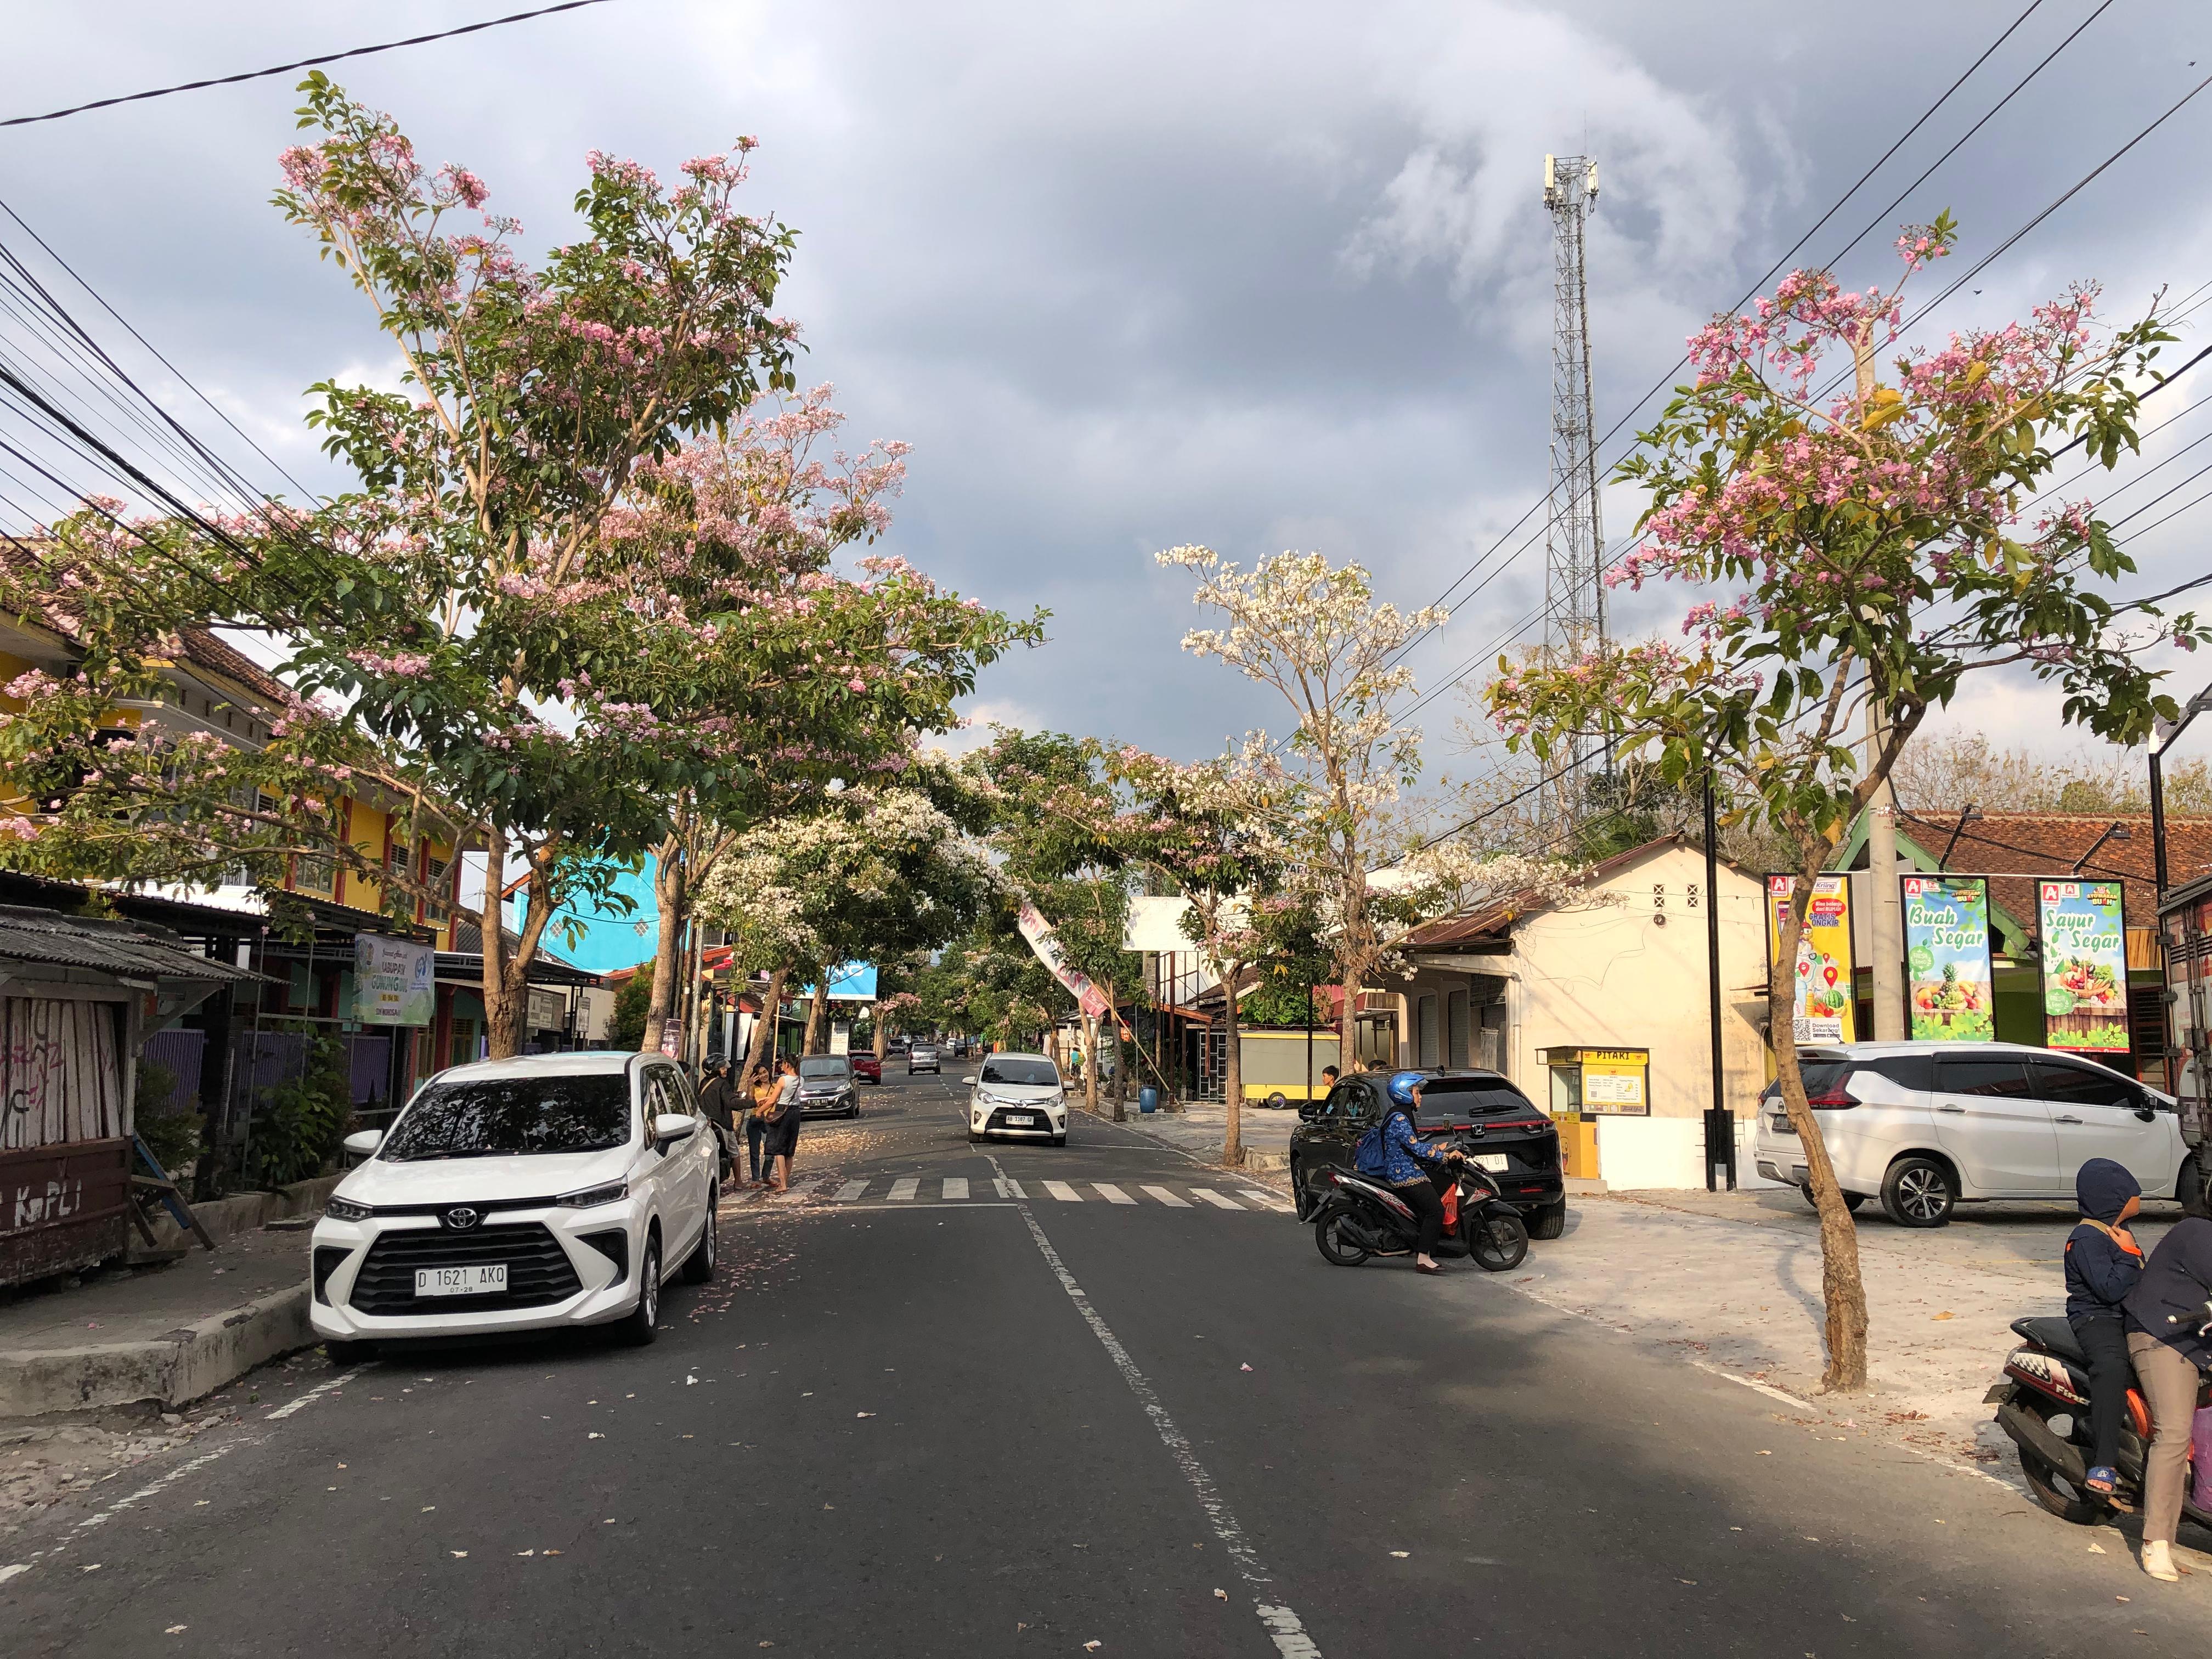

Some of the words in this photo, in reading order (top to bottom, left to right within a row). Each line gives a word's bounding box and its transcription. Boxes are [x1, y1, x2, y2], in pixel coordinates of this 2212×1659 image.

[1909, 905, 1955, 926] Buah
[2046, 909, 2094, 932] Sayur
[1934, 927, 1983, 950] Segar
[2071, 930, 2119, 953] Segar
[1596, 1051, 1629, 1060] PITAKI
[1474, 1156, 1489, 1166] 521
[418, 1272, 426, 1288] D
[437, 1269, 467, 1286] 1621
